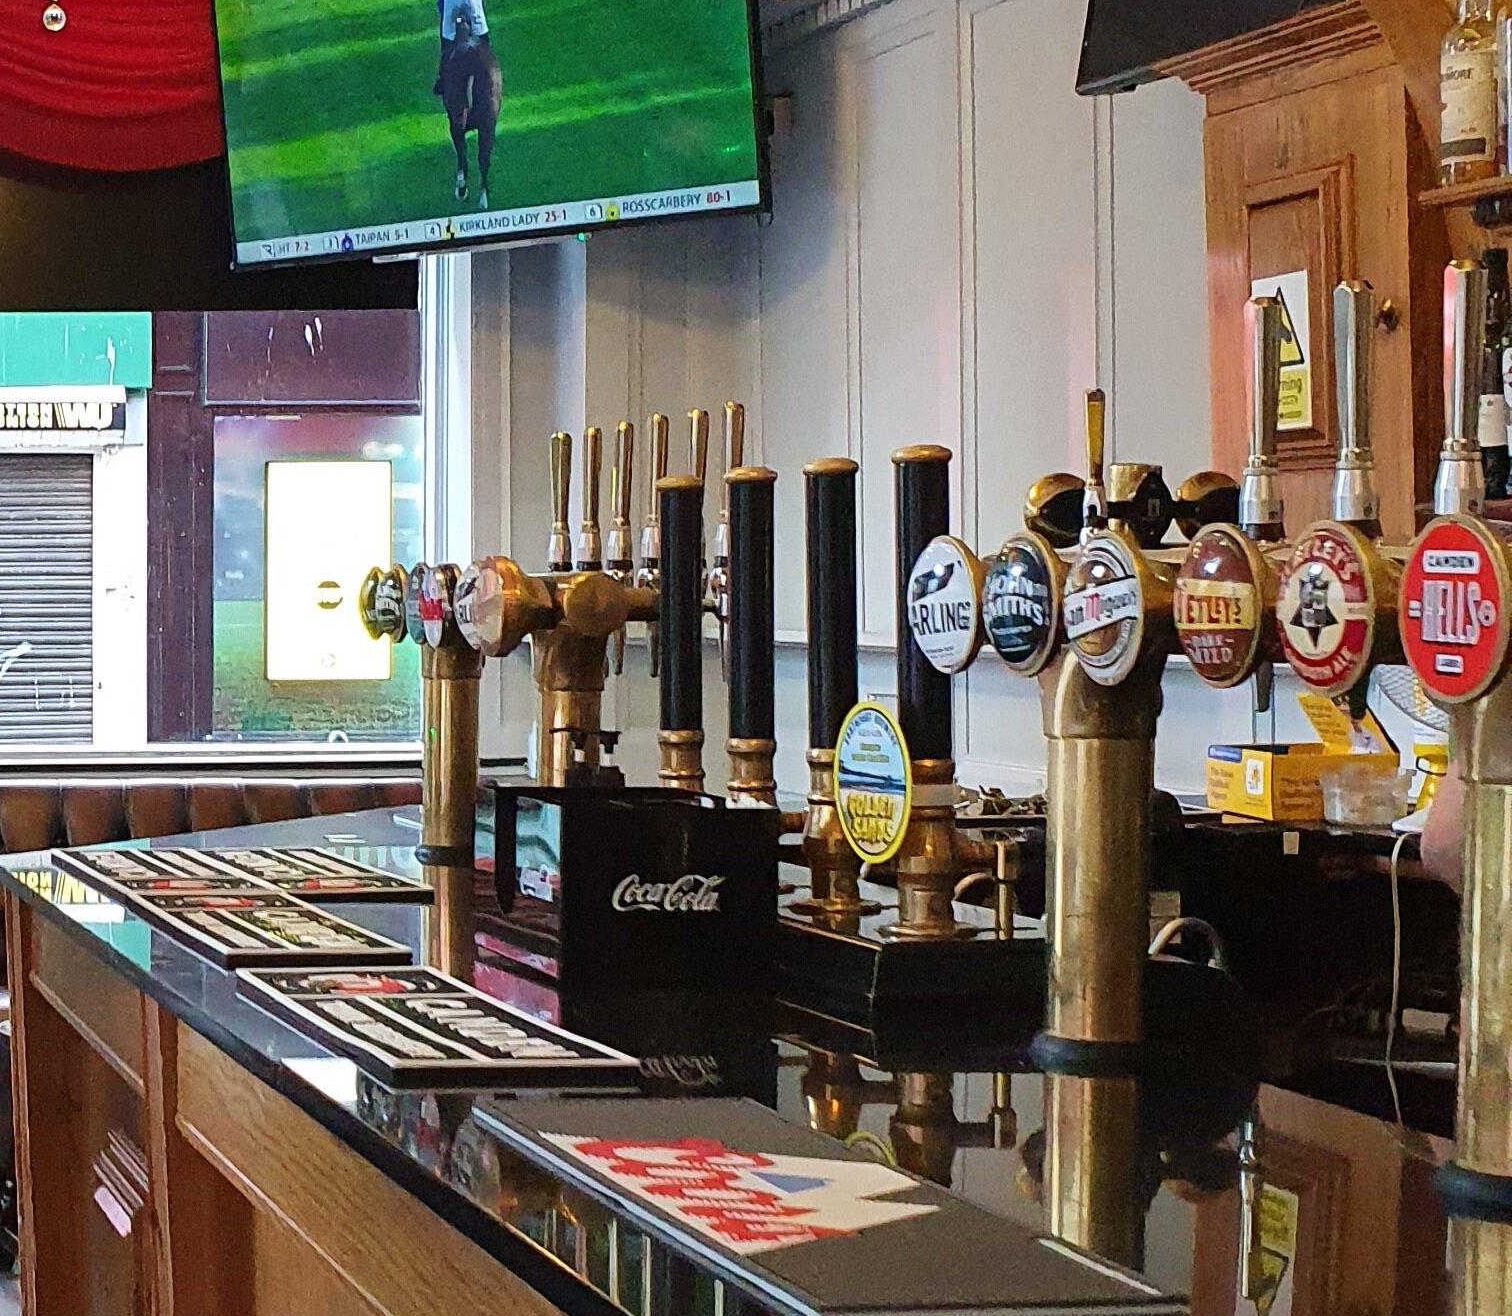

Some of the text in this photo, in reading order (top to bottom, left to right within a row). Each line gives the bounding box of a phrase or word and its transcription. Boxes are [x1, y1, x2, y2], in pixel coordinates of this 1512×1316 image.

[356, 233, 390, 245] TAIPAN
[459, 217, 510, 233] KIRKLAND
[512, 212, 541, 228] LADY
[544, 209, 567, 223] 25-1
[622, 193, 702, 215] ROSSCARBERY
